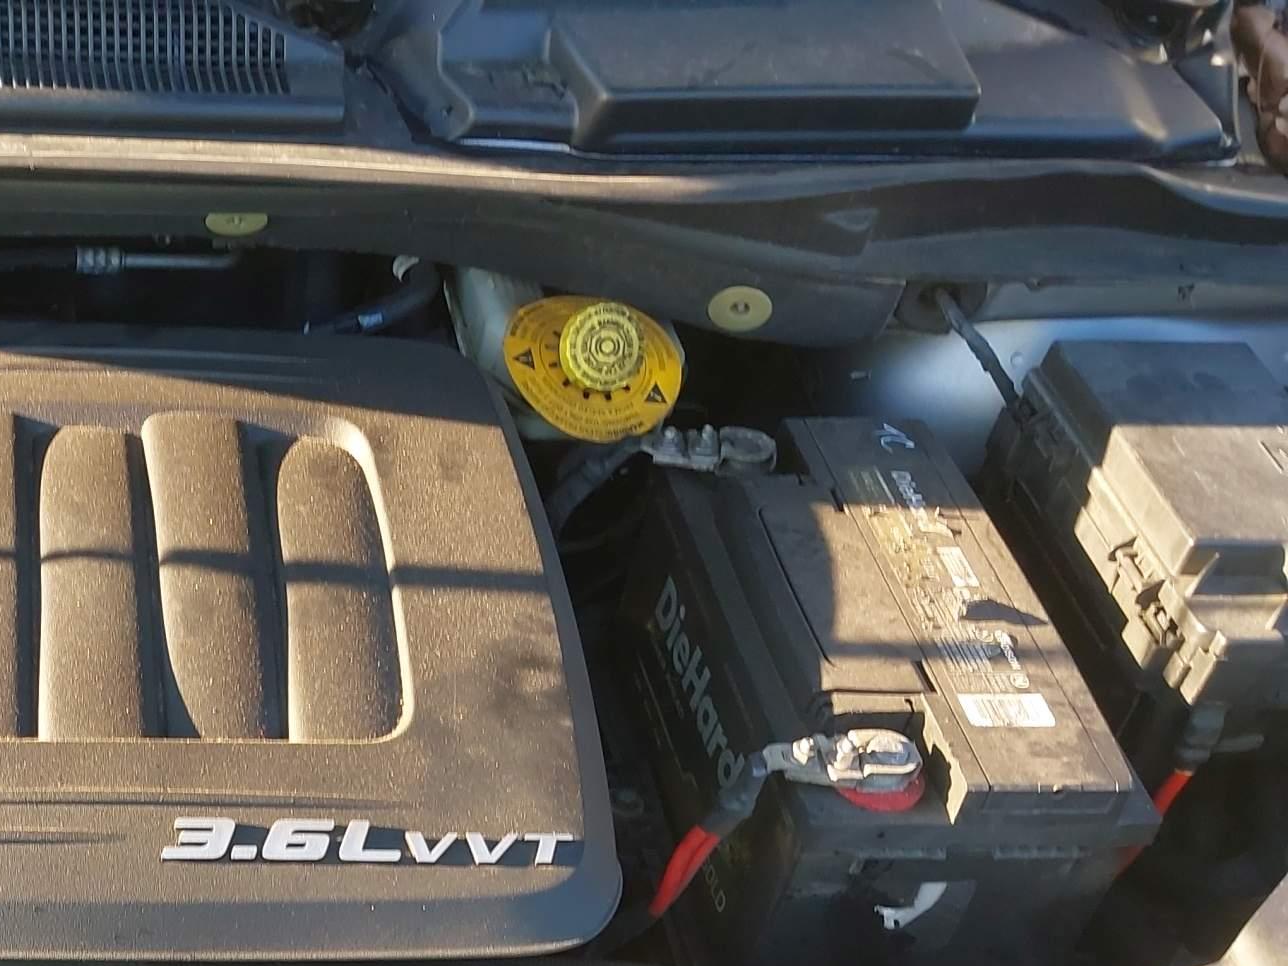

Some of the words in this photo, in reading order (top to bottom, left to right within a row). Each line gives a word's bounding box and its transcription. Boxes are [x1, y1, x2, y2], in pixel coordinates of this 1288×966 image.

[655, 575, 745, 790] DieHard
[161, 817, 401, 862] 3.6L
[404, 831, 574, 867] VVT
